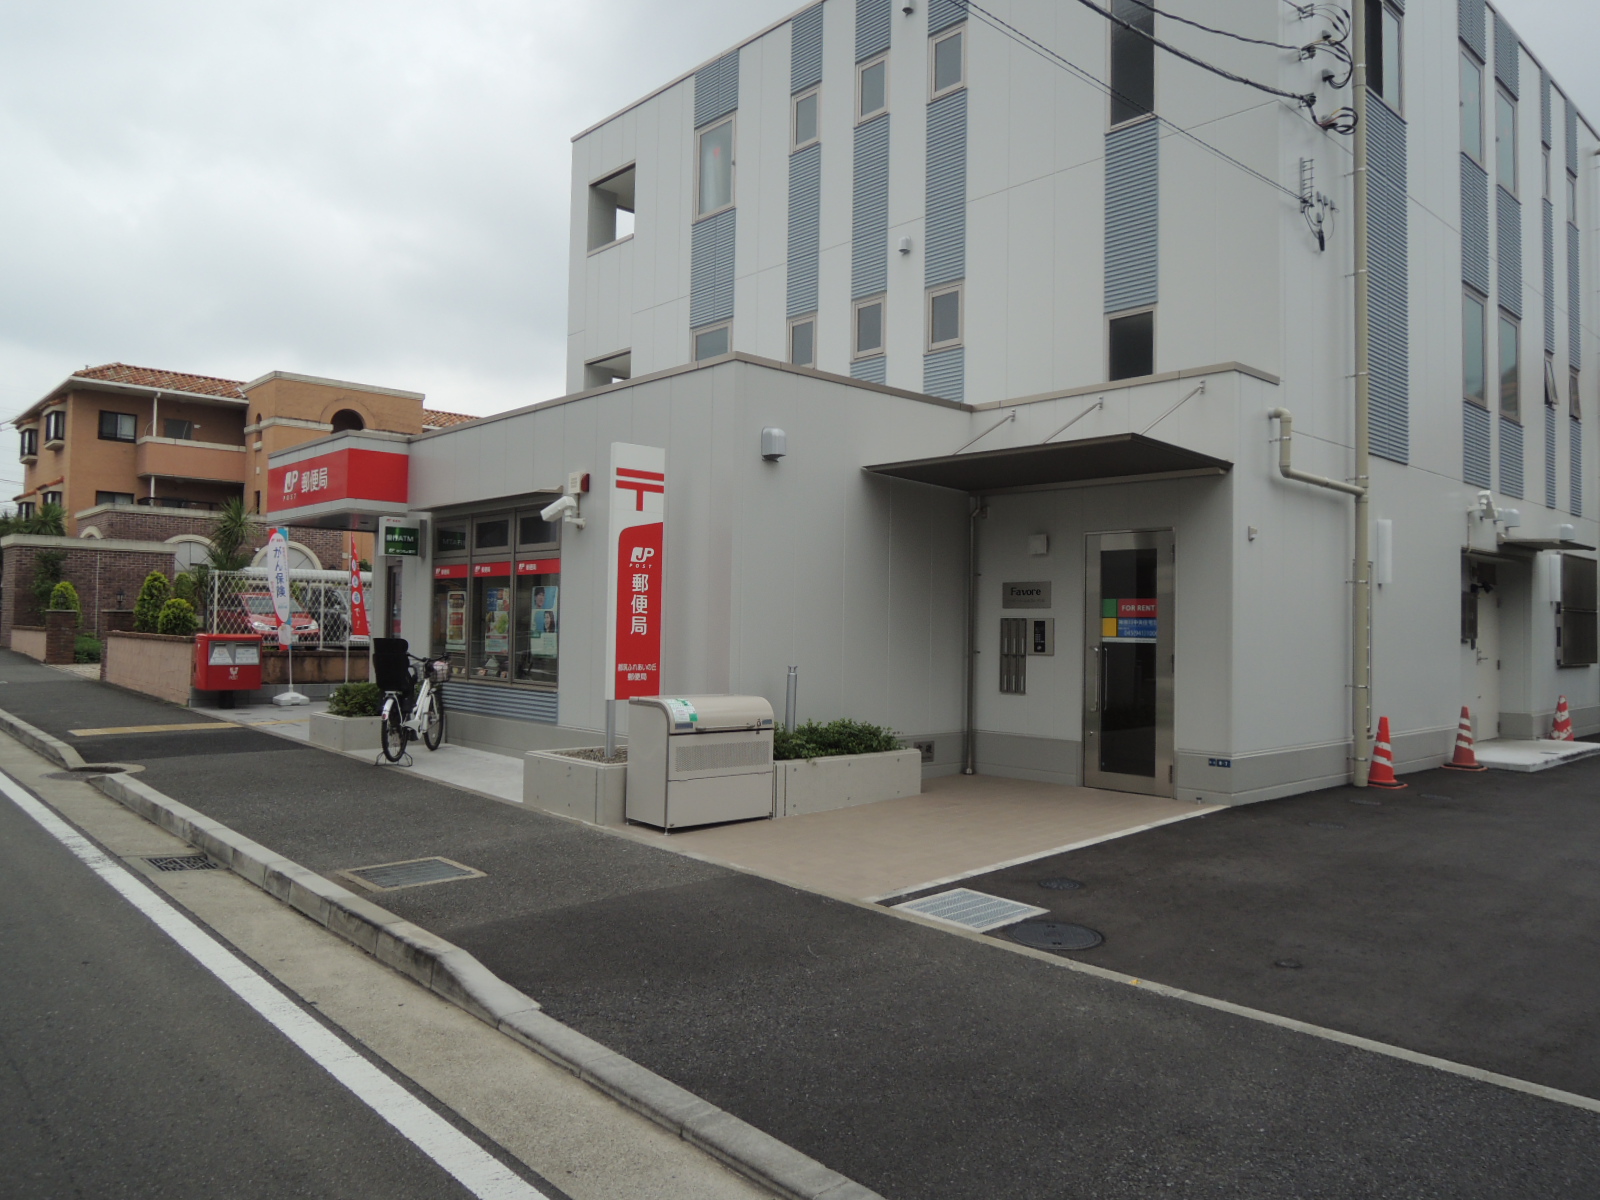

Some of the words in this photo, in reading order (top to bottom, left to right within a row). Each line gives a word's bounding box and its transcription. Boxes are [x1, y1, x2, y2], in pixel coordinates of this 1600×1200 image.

[284, 471, 298, 493] JP
[301, 467, 328, 493] 郵便局
[283, 493, 297, 502] POST
[630, 546, 655, 563] JP
[273, 546, 287, 599] がん保険
[1010, 587, 1042, 596] Favore
[630, 573, 649, 635] 郵便局
[1121, 604, 1136, 612] FOR
[1137, 604, 1155, 612] RENT
[627, 672, 648, 681] 郵便局
